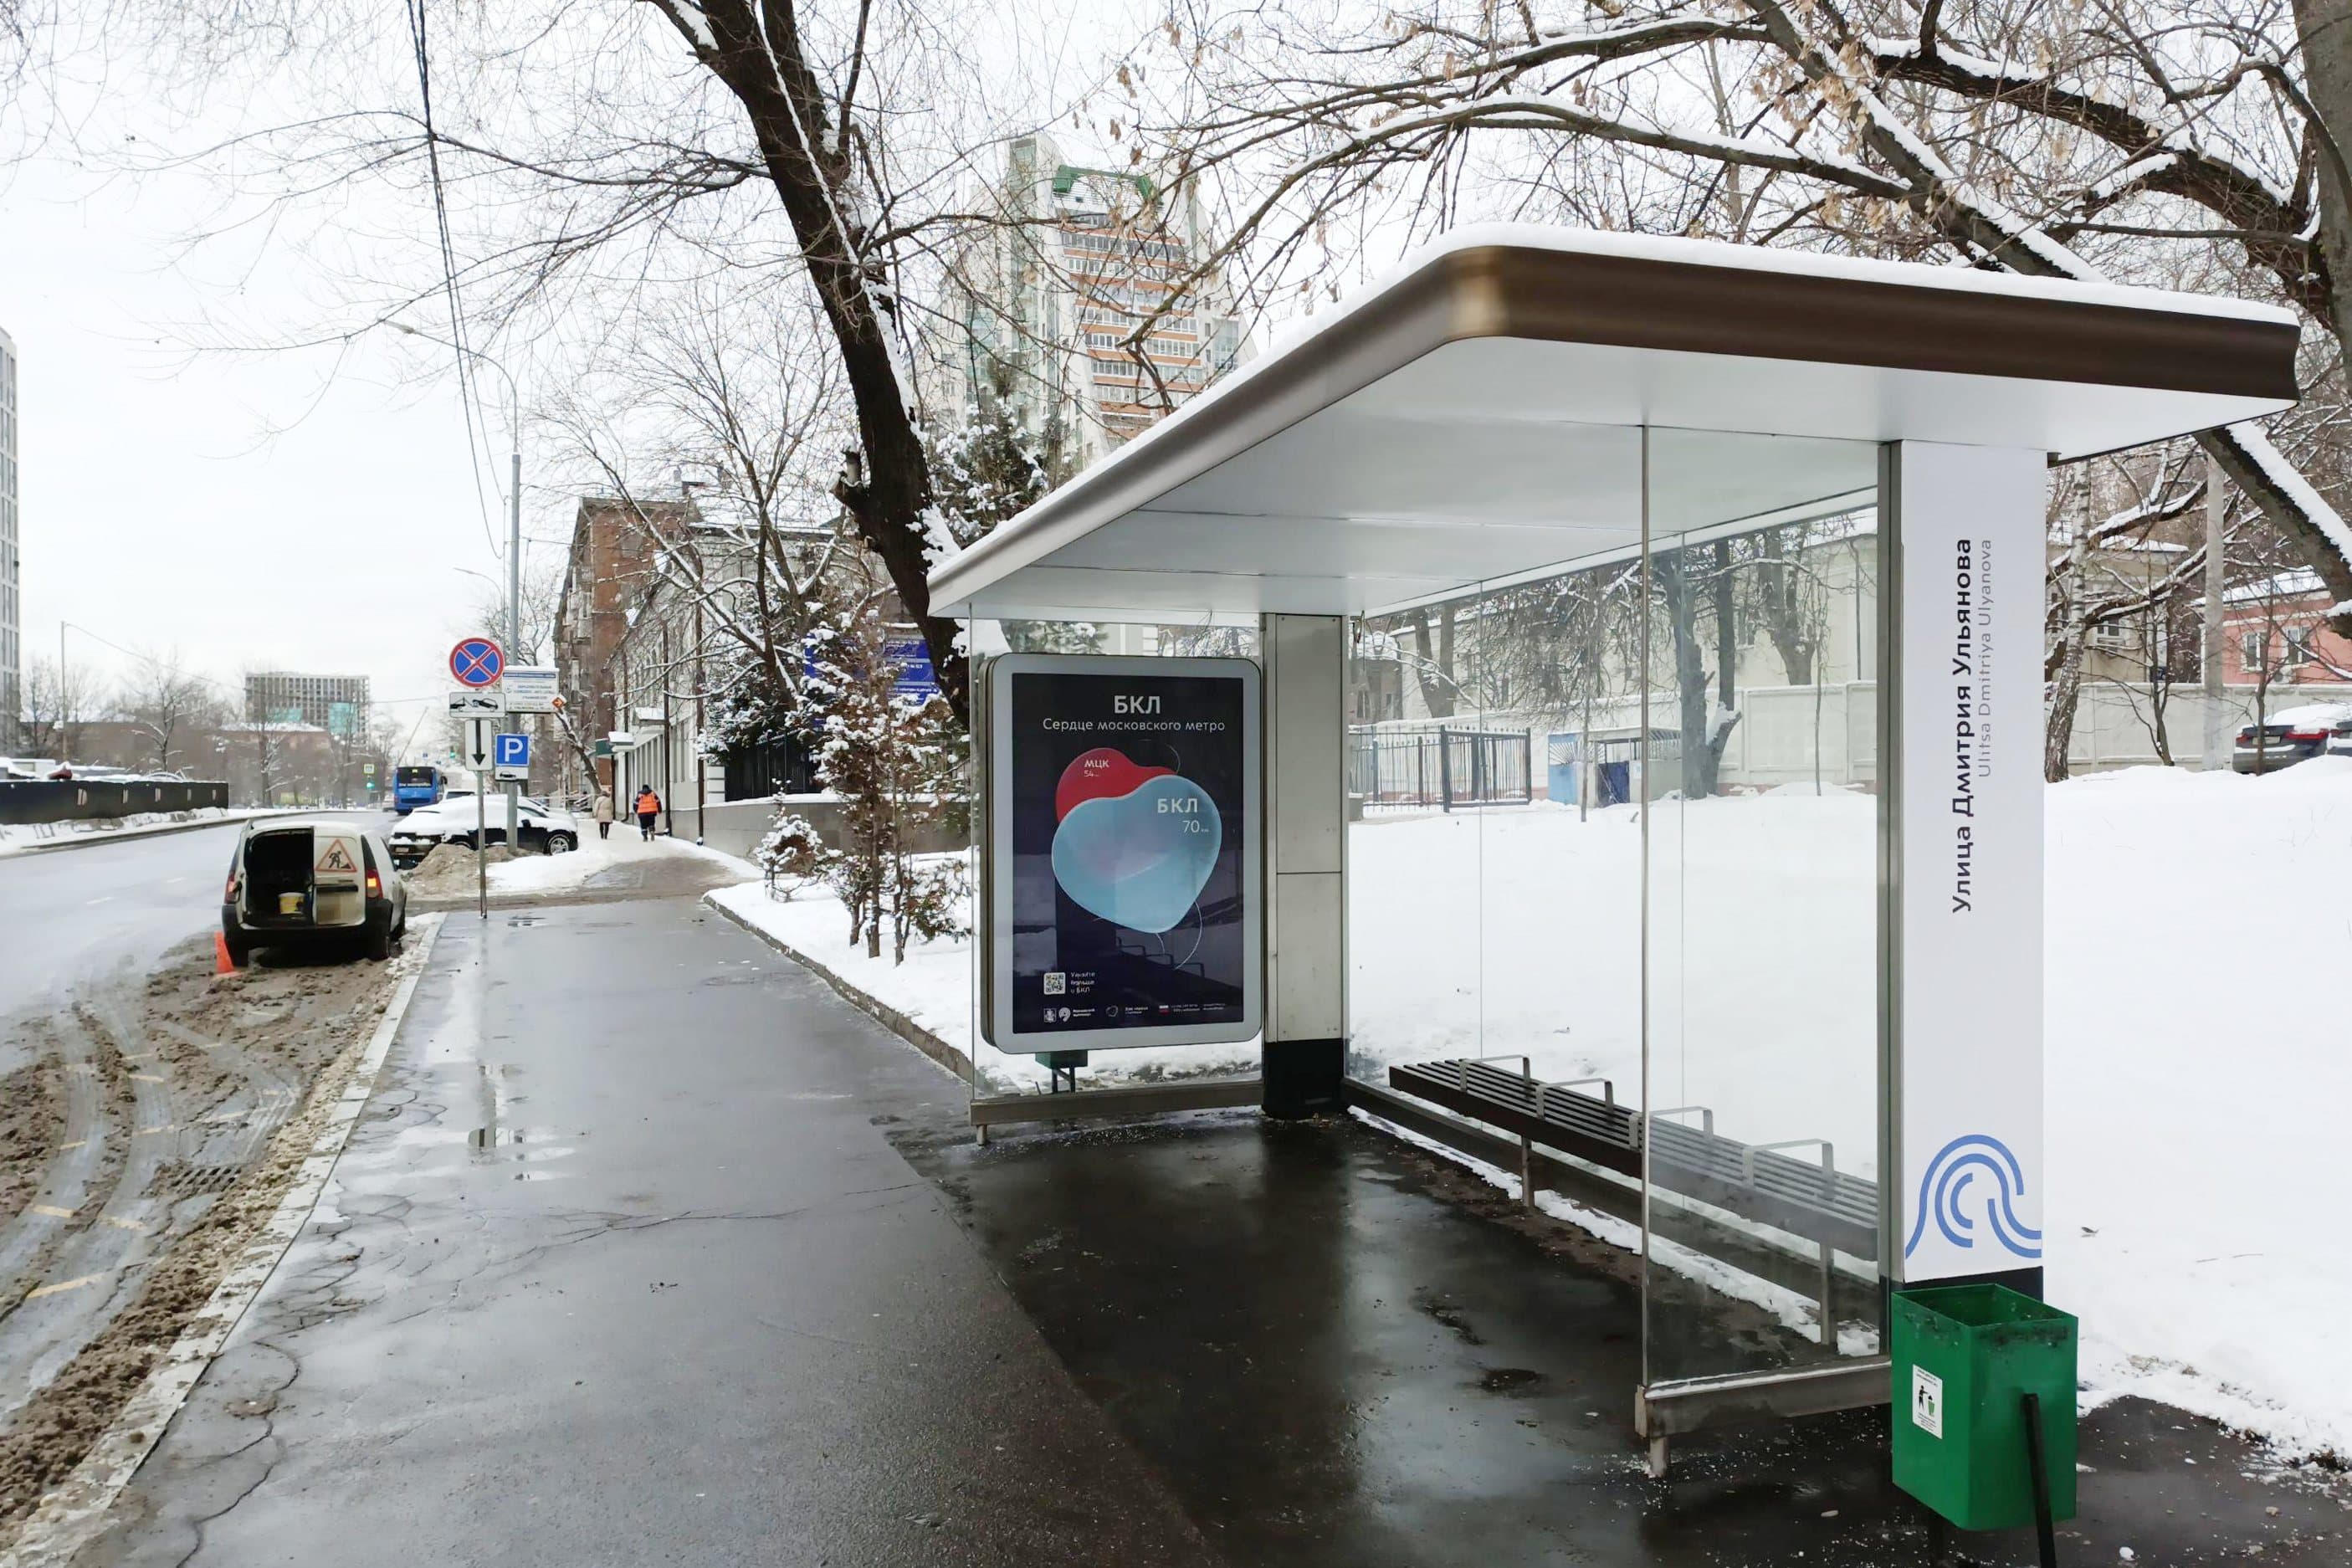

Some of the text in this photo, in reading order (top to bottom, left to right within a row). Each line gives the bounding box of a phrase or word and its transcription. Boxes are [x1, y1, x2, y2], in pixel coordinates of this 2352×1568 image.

[1978, 540, 1994, 777] Ulitsa Dmitriya Ulyanova
[1114, 695, 1161, 714] БКЛ
[1043, 718, 1226, 732] Сердце московского метро
[1952, 539, 1975, 913] Улица Дмитрия Ульянова
[504, 737, 524, 762] P
[1084, 759, 1110, 769] МЦК
[1157, 798, 1198, 813] БКЛ
[1181, 820, 1200, 833] 70
